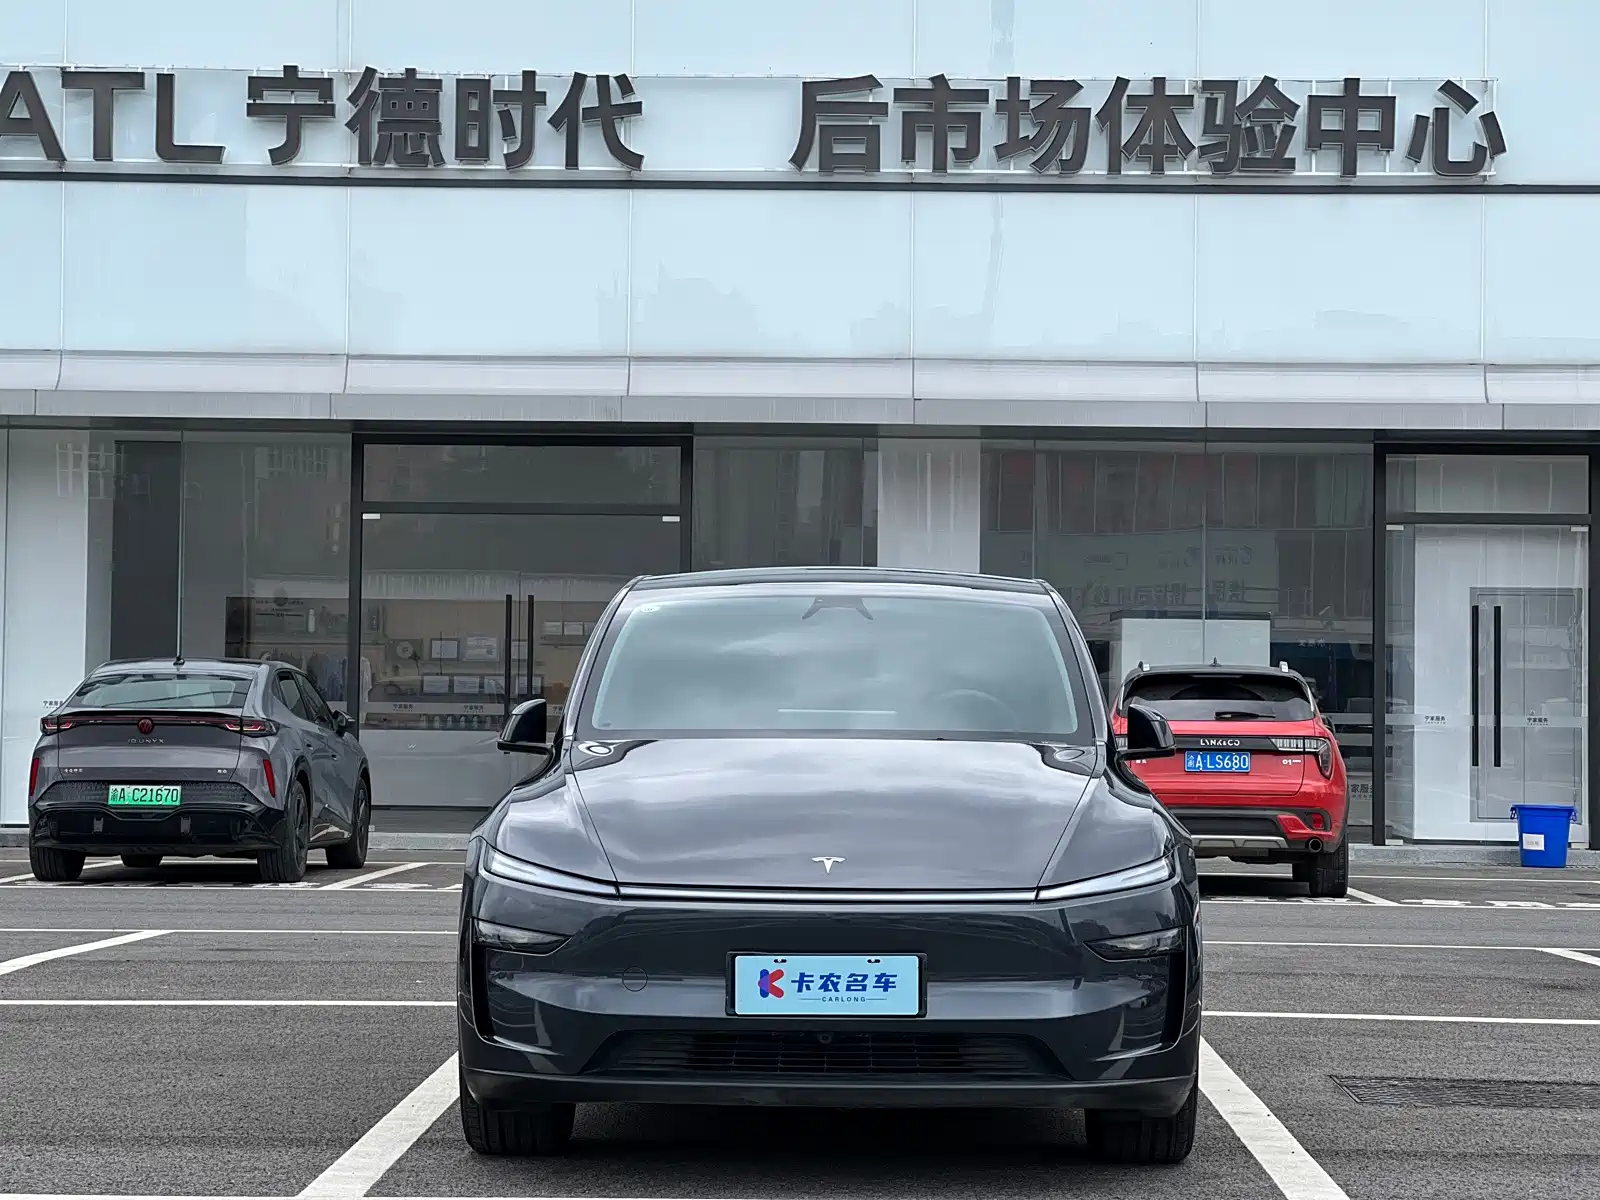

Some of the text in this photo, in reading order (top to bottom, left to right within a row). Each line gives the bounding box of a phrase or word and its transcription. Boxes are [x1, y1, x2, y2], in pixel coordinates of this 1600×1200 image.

[246, 65, 645, 171] 宁德时代
[789, 74, 1507, 178] 后市场体验中心
[1200, 738, 1241, 746] LYNK&CO
[790, 972, 898, 993] 卡农名车
[821, 995, 867, 1003] CARLONG
